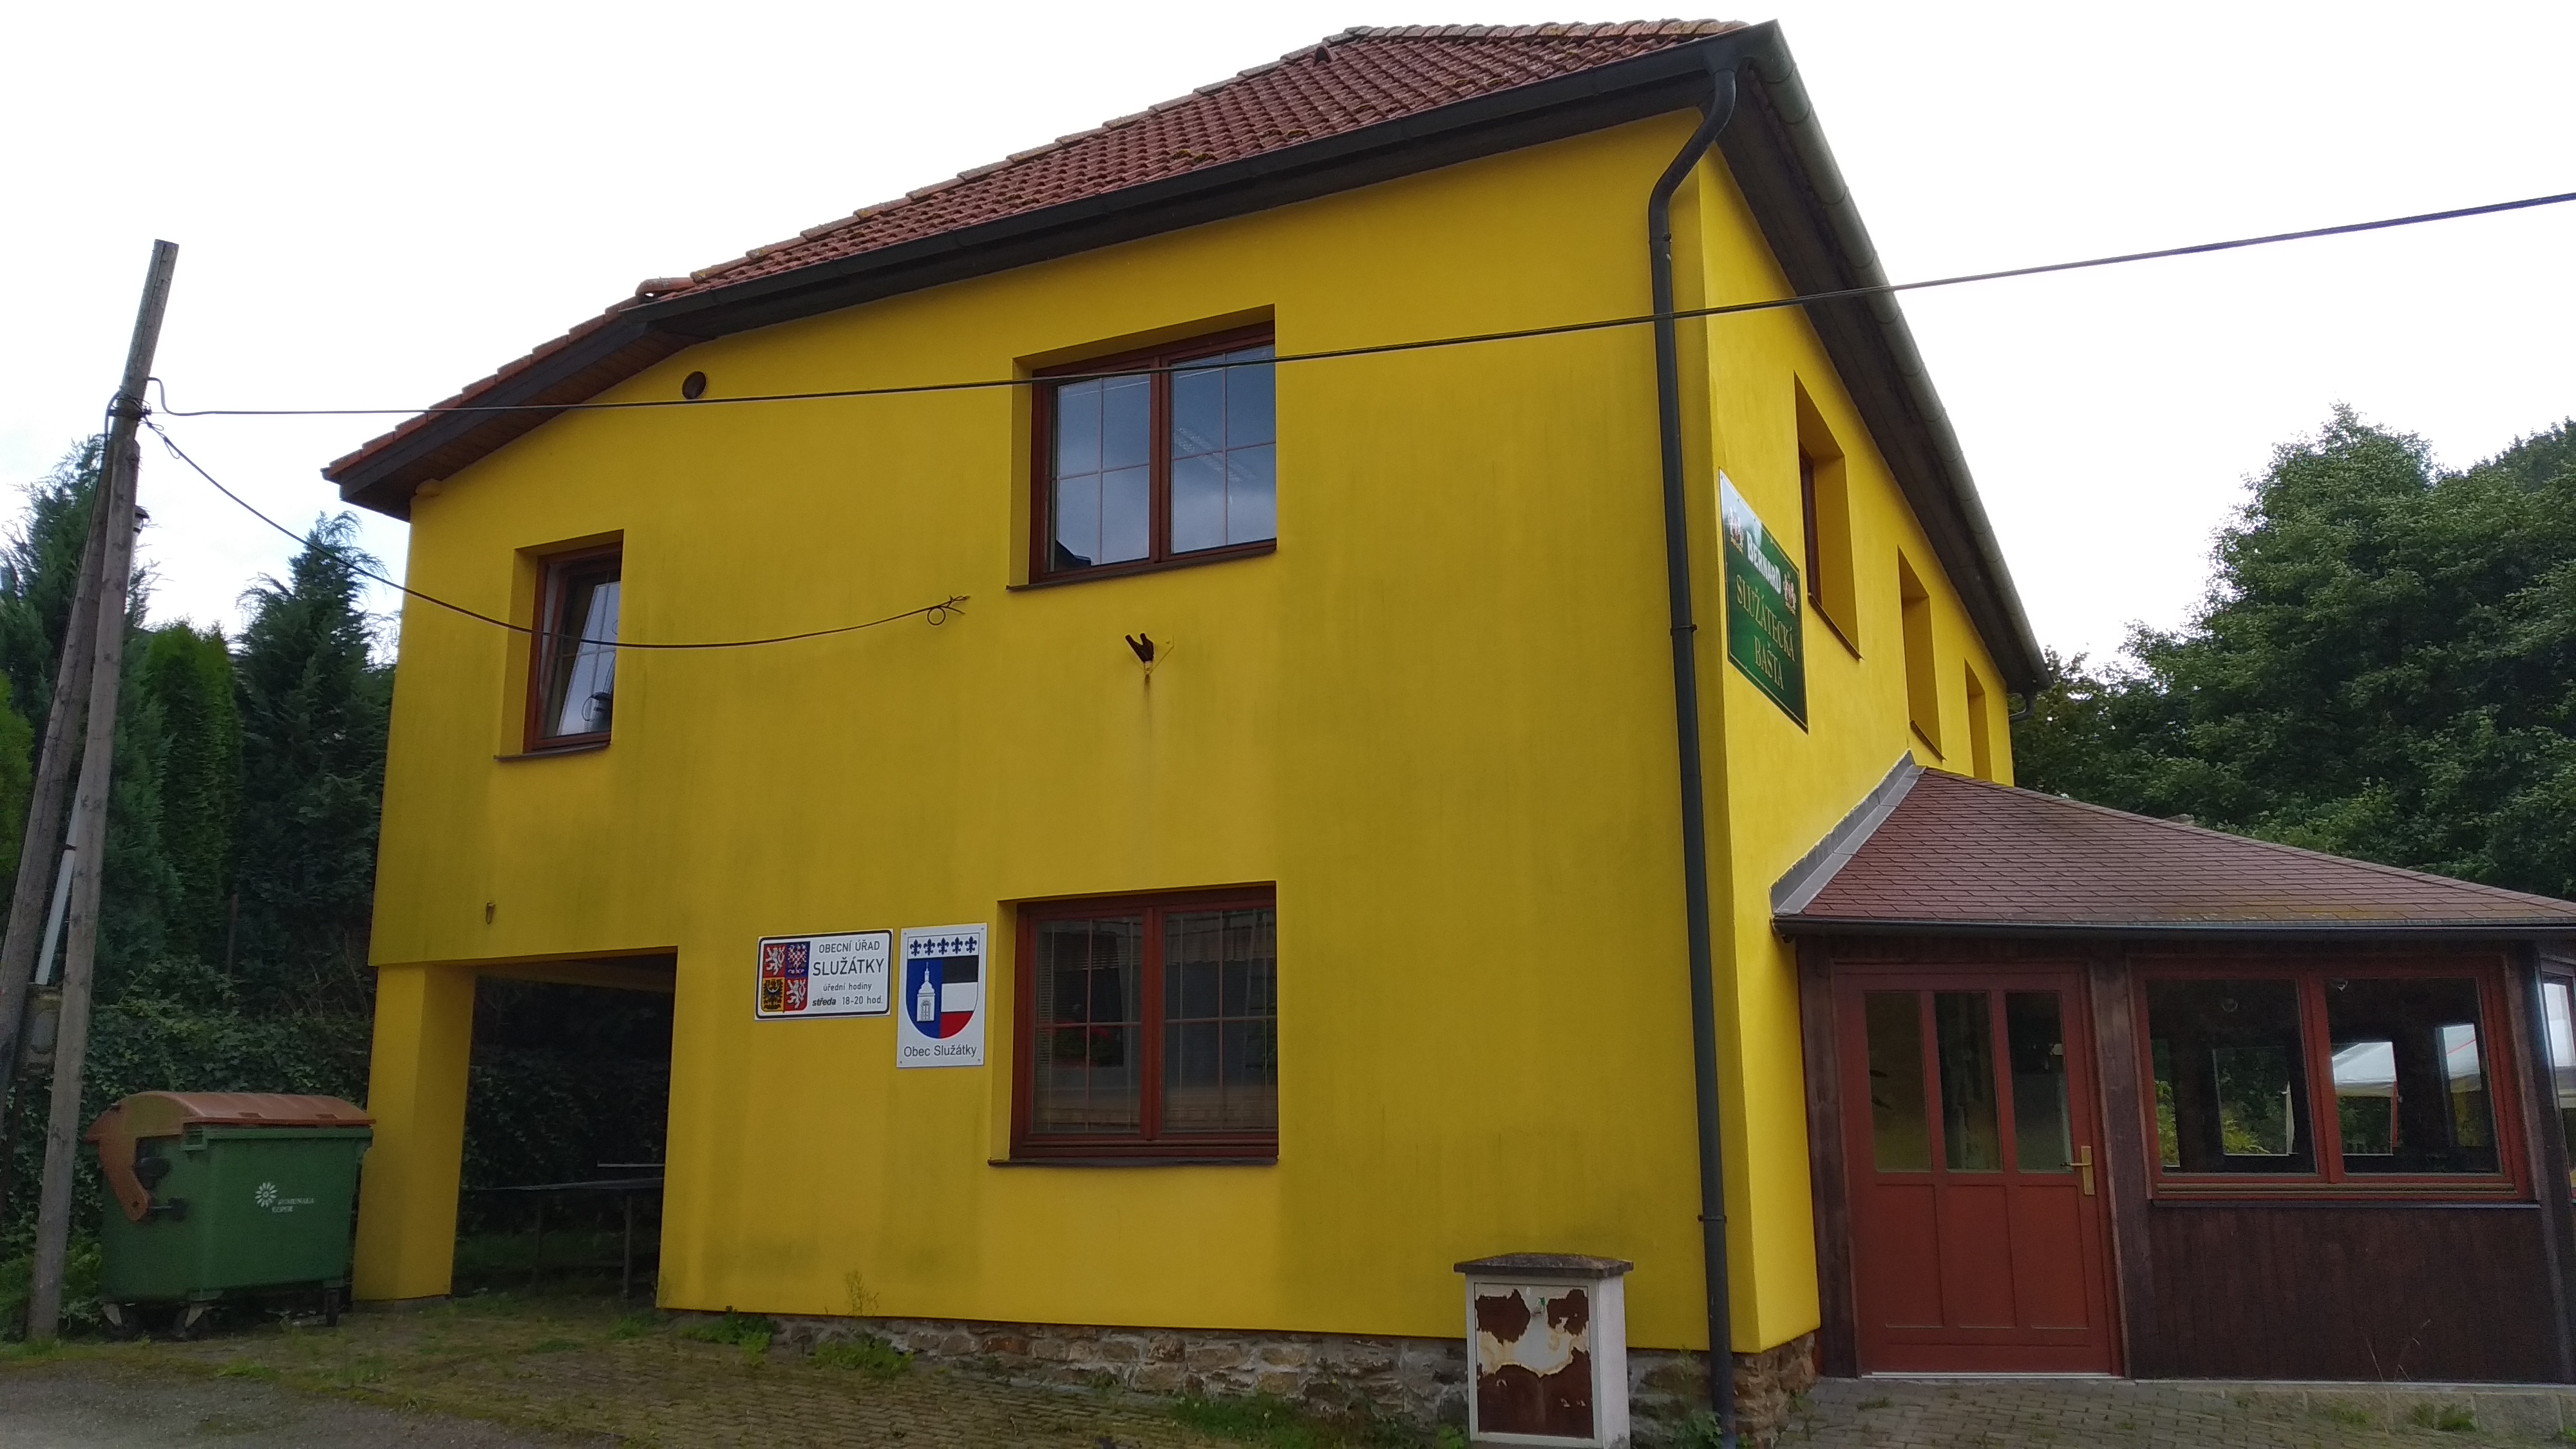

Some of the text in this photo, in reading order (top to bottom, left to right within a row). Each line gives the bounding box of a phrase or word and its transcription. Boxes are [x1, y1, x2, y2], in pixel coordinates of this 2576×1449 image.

[1747, 530, 1781, 594] BERNARD
[1736, 574, 1795, 662] SLUŽÁTECKÁ
[1754, 635, 1785, 690] BAŠTA
[819, 940, 880, 953] OBECNÍ ÚŘAD
[812, 956, 885, 976] SLUŽÁTKY
[823, 982, 872, 992] úřední hodiny
[812, 995, 884, 1007] středa 18-20 hod.
[904, 1044, 977, 1058] Obec Služátky
